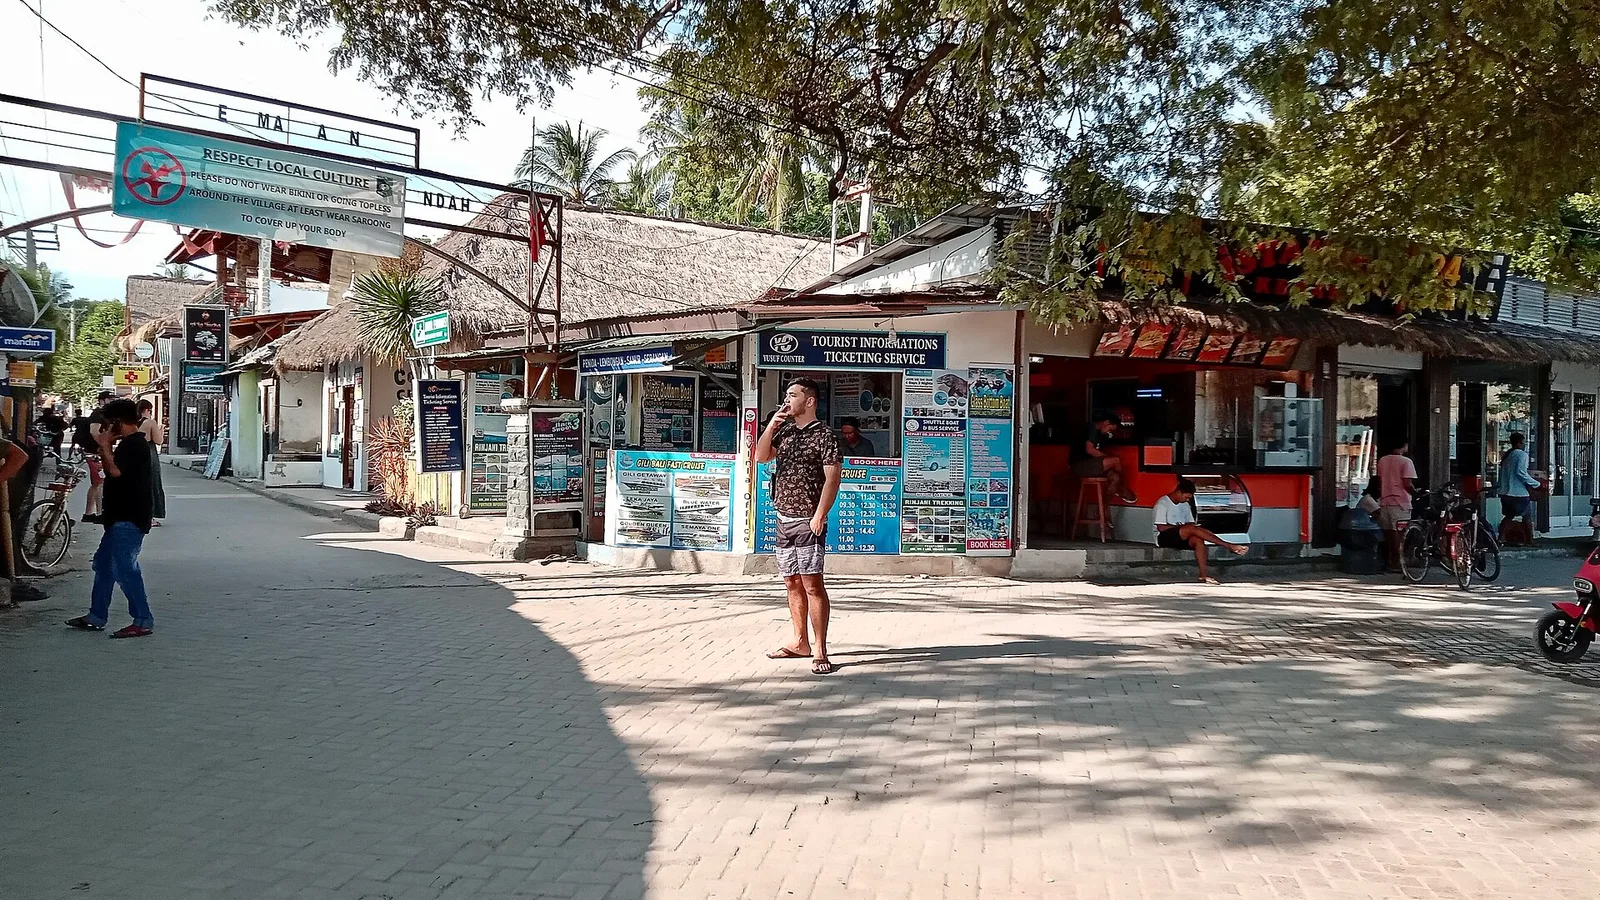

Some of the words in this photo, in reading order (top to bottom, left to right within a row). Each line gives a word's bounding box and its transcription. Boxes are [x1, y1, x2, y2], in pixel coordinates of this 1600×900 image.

[203, 148, 263, 168] RESPECT
[267, 160, 309, 178] LOCAL
[313, 169, 370, 188] CULTURE
[190, 171, 222, 184] PLEASE
[225, 176, 238, 186] DO
[240, 179, 260, 189] NOT
[261, 183, 287, 194] WEAR
[289, 187, 315, 199] BIKINI
[317, 192, 329, 202] OR
[330, 194, 357, 207] GOING
[358, 200, 391, 213] TOPLESS
[189, 188, 230, 202] AROUND
[231, 194, 249, 205] THE
[250, 198, 286, 212] VILLAGE
[287, 203, 299, 213] AT
[300, 206, 324, 218] LEAST
[326, 211, 351, 222] WEAR
[352, 215, 391, 229] SAROONG
[241, 213, 253, 223] TO
[255, 215, 283, 228] COVER
[285, 220, 297, 230] UP
[298, 223, 322, 235] YOUR
[324, 227, 347, 238] BODY
[811, 335, 858, 348] TOURIST
[860, 336, 938, 350] INFORMATIONS
[763, 354, 780, 363] YUSUF
[780, 355, 805, 363] COUNTER
[823, 351, 882, 364] TICKETING
[884, 353, 926, 365] SERVICE
[475, 444, 498, 452] RINJANI
[637, 459, 650, 468] GILI
[651, 459, 666, 468] BALI
[667, 460, 683, 469] FAST
[683, 461, 706, 470] CRUISE
[841, 469, 867, 479] CRUISE
[990, 541, 1007, 549] HERE
